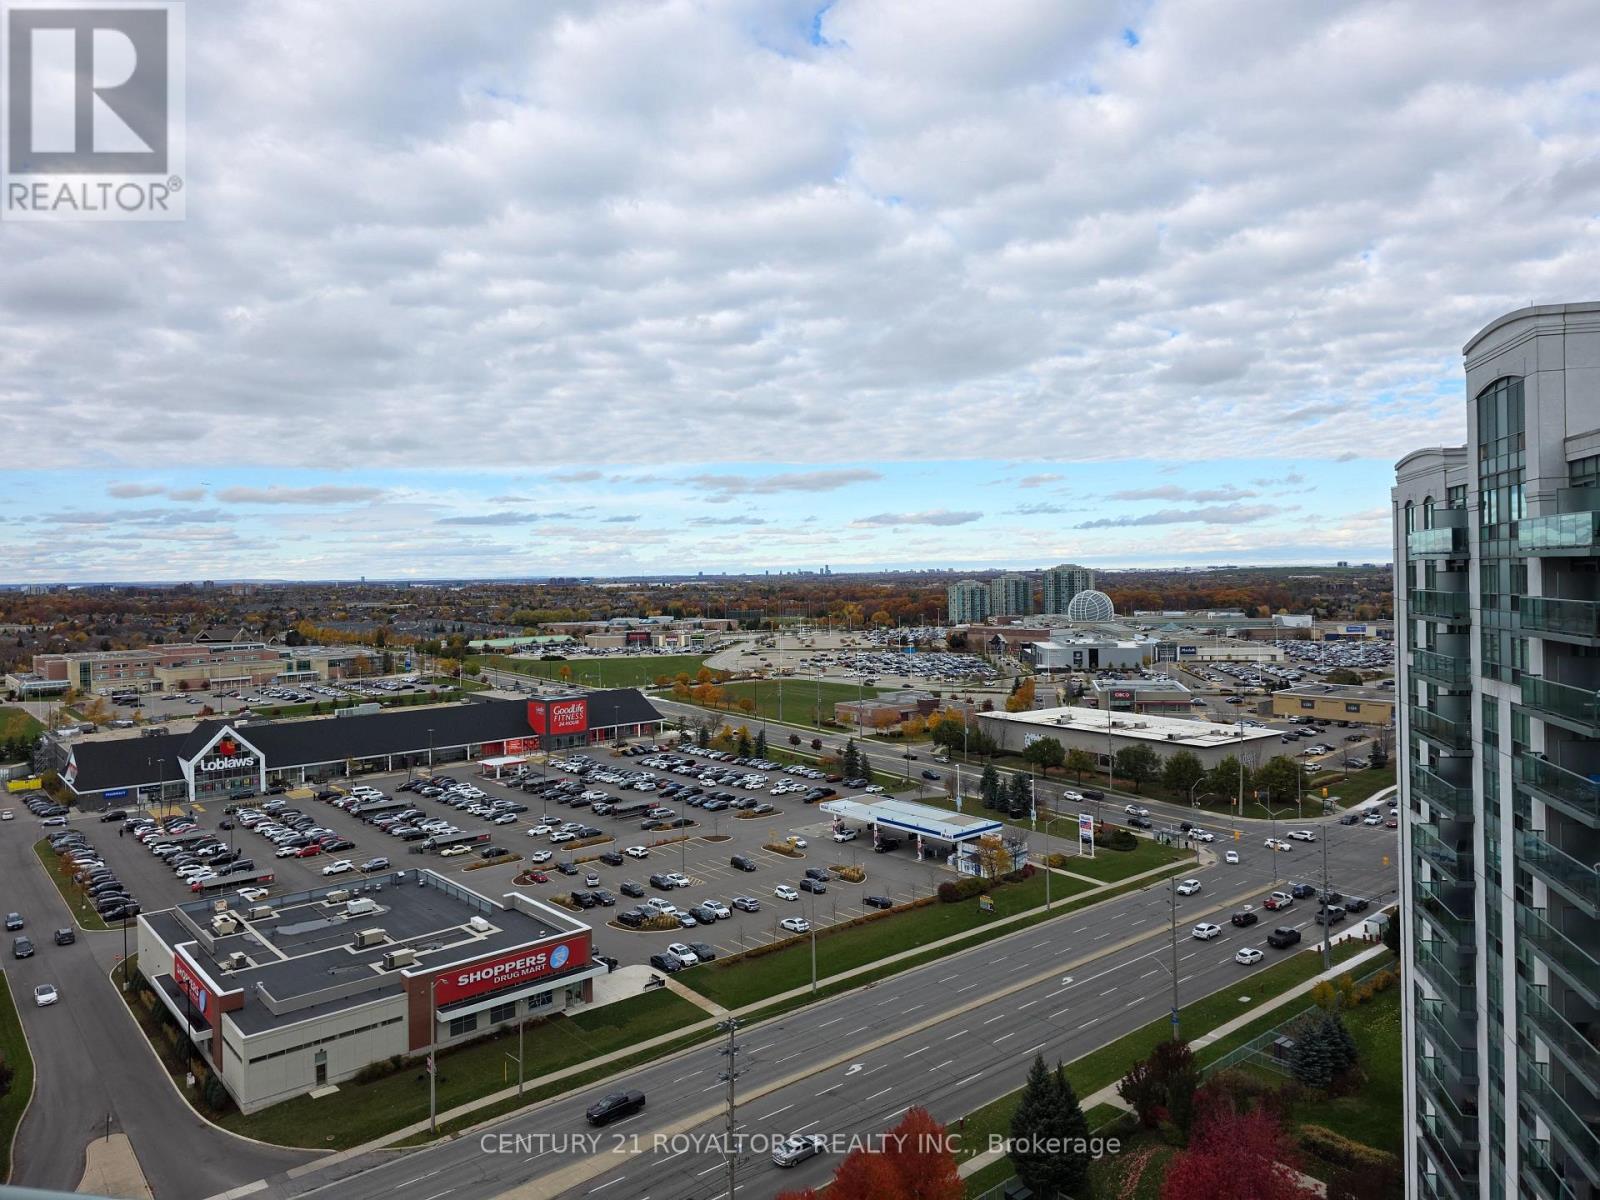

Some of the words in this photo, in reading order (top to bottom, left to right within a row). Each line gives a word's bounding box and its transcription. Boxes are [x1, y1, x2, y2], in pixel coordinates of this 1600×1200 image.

[553, 712, 584, 722] FITNESS
[200, 756, 254, 771] Loblaws
[458, 952, 547, 986] SHOPPERS
[493, 972, 520, 984] DRUG
[521, 963, 547, 976] MART
